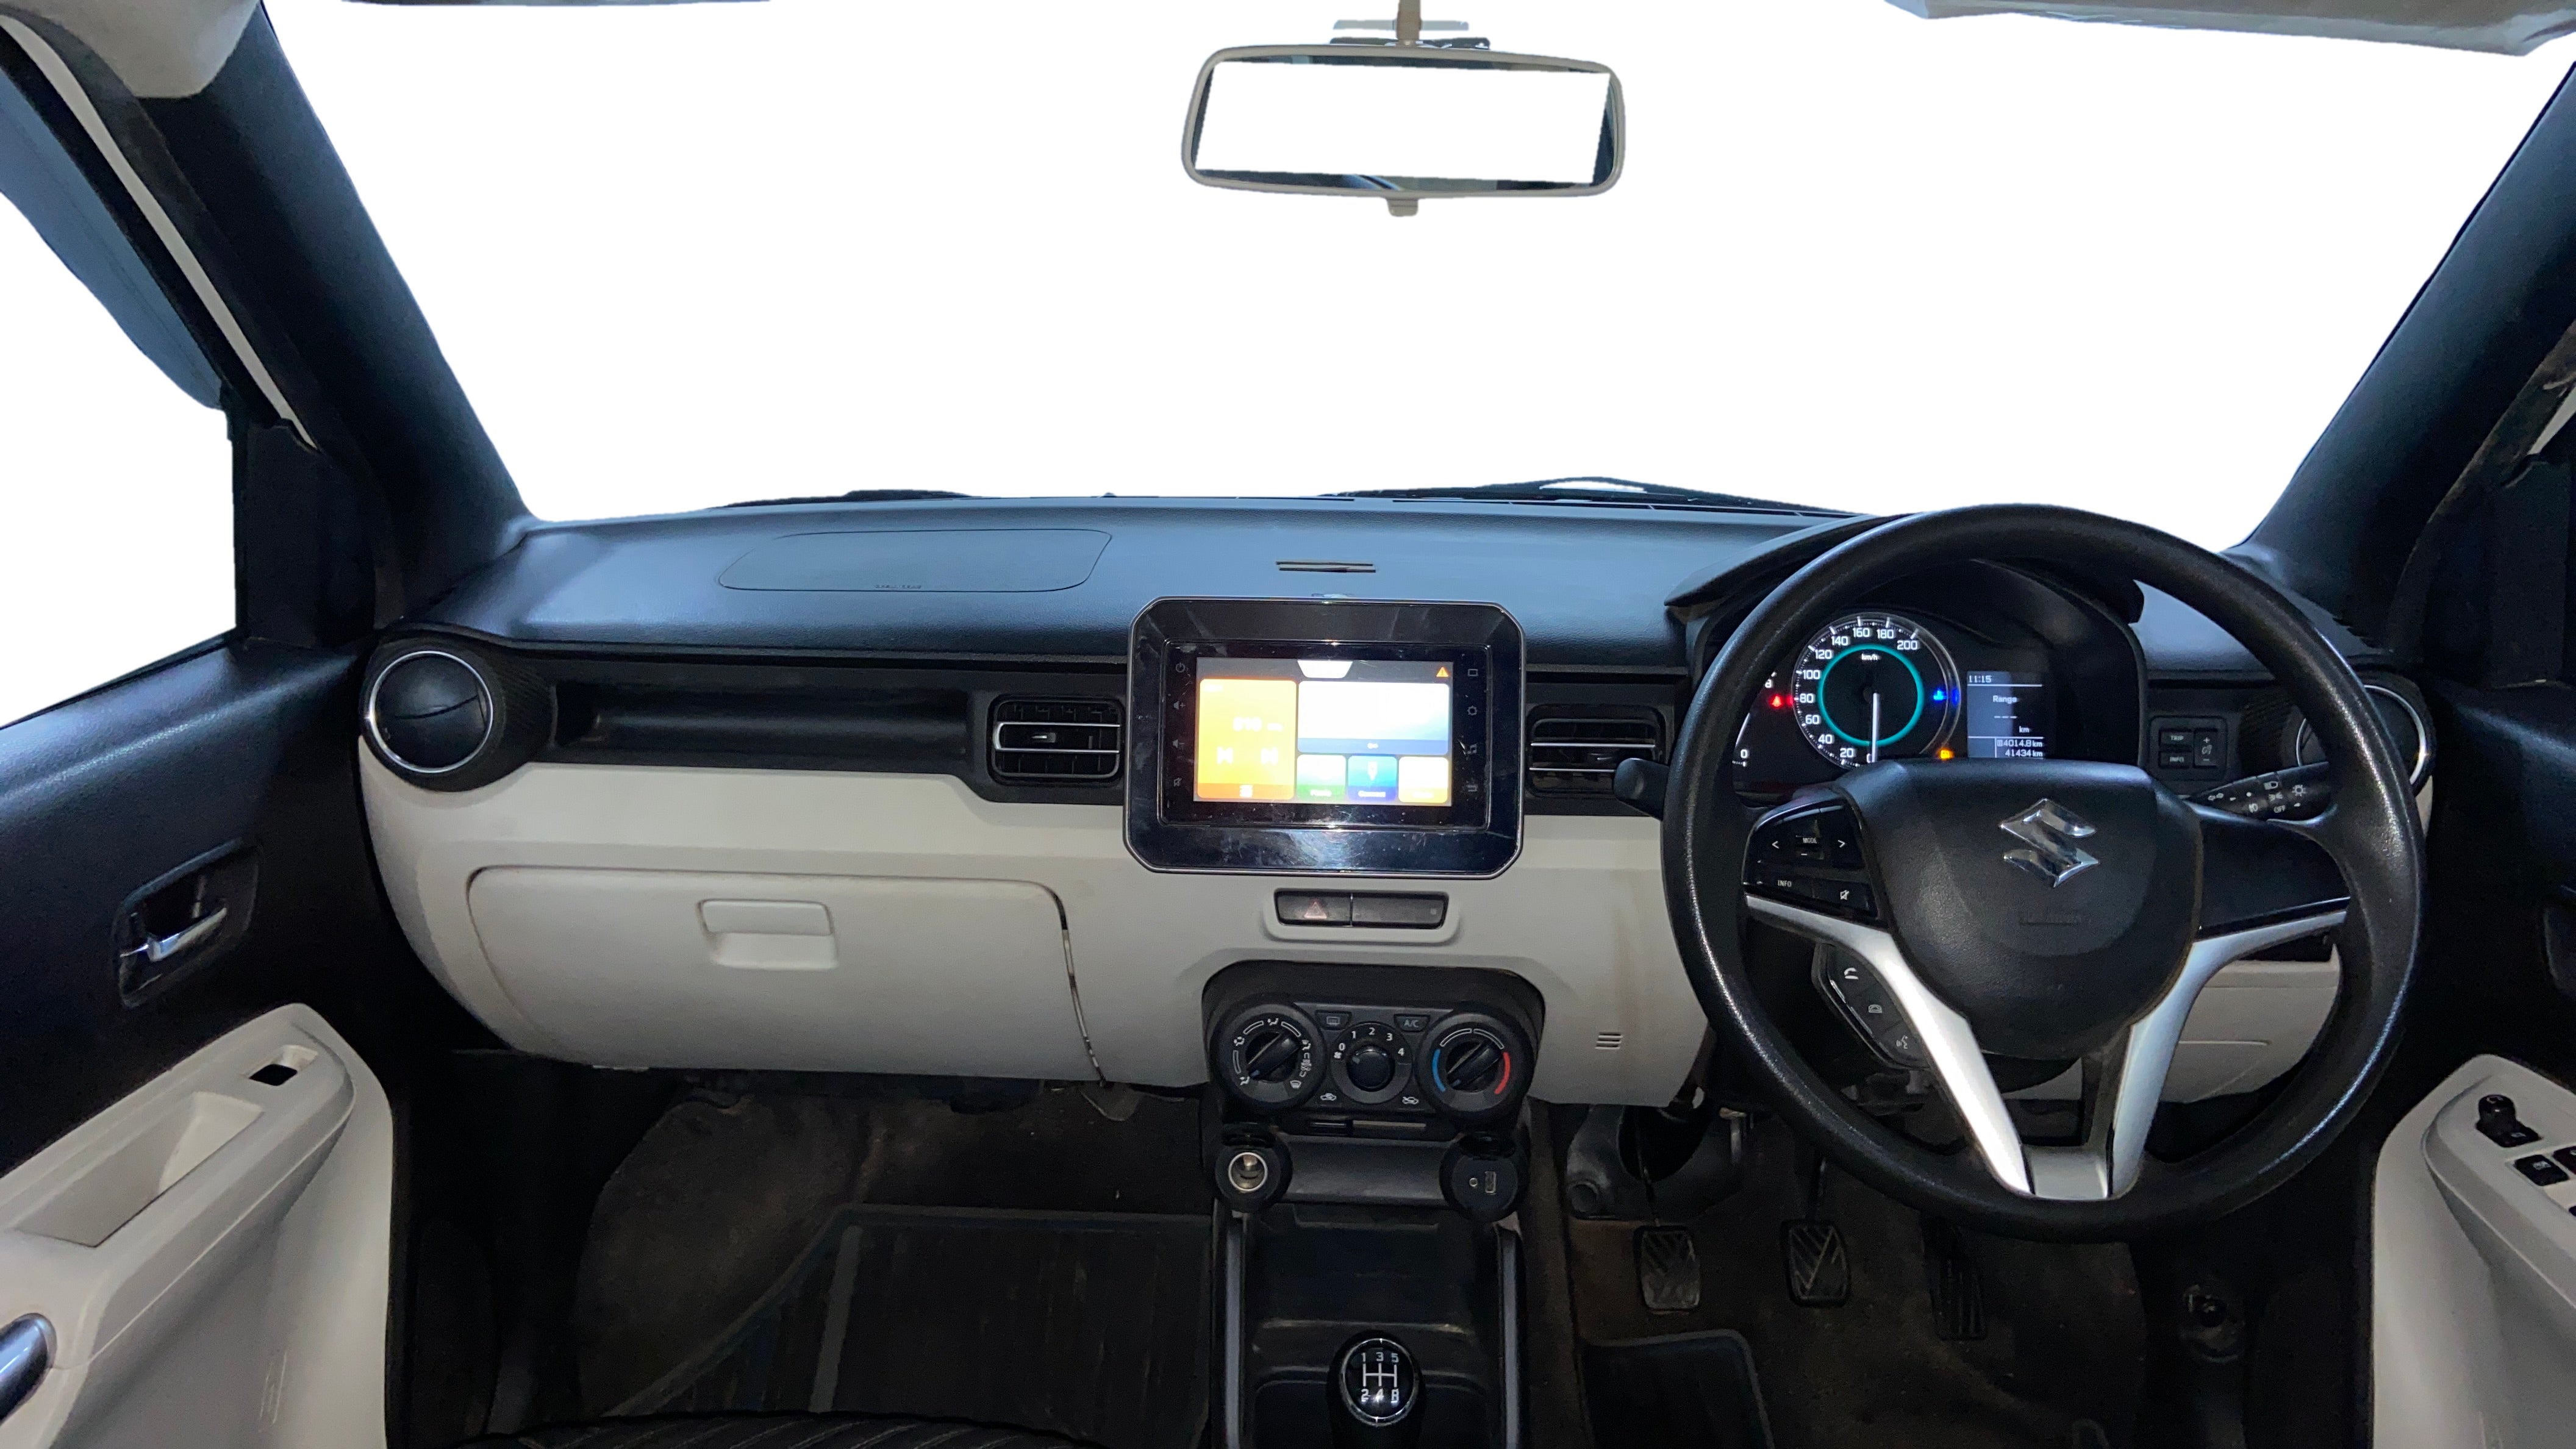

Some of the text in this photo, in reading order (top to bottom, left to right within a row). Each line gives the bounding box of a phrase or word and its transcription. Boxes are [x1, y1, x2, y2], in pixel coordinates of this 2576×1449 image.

[1853, 628, 1870, 637] 160
[1877, 629, 1894, 639] 180
[1831, 636, 1849, 646] 140
[1897, 640, 1918, 650] 200
[1815, 649, 1833, 659] 120
[1803, 670, 1821, 679] 100
[1800, 693, 1815, 703] 80
[1992, 695, 2017, 704] Range
[1805, 715, 1820, 724] 60
[1818, 734, 1834, 744] 40
[1741, 750, 1748, 759] 0
[1839, 748, 1855, 758] 20
[1404, 1019, 1419, 1028] A/C
[1351, 1031, 1356, 1039] 1
[1368, 1027, 1375, 1036] 2
[1386, 1032, 1393, 1041] 3
[1397, 1047, 1405, 1056] 4
[1361, 1352, 1399, 1363] 1 3 5
[1361, 1389, 1370, 1402] 2
[1375, 1388, 1384, 1402] 4
